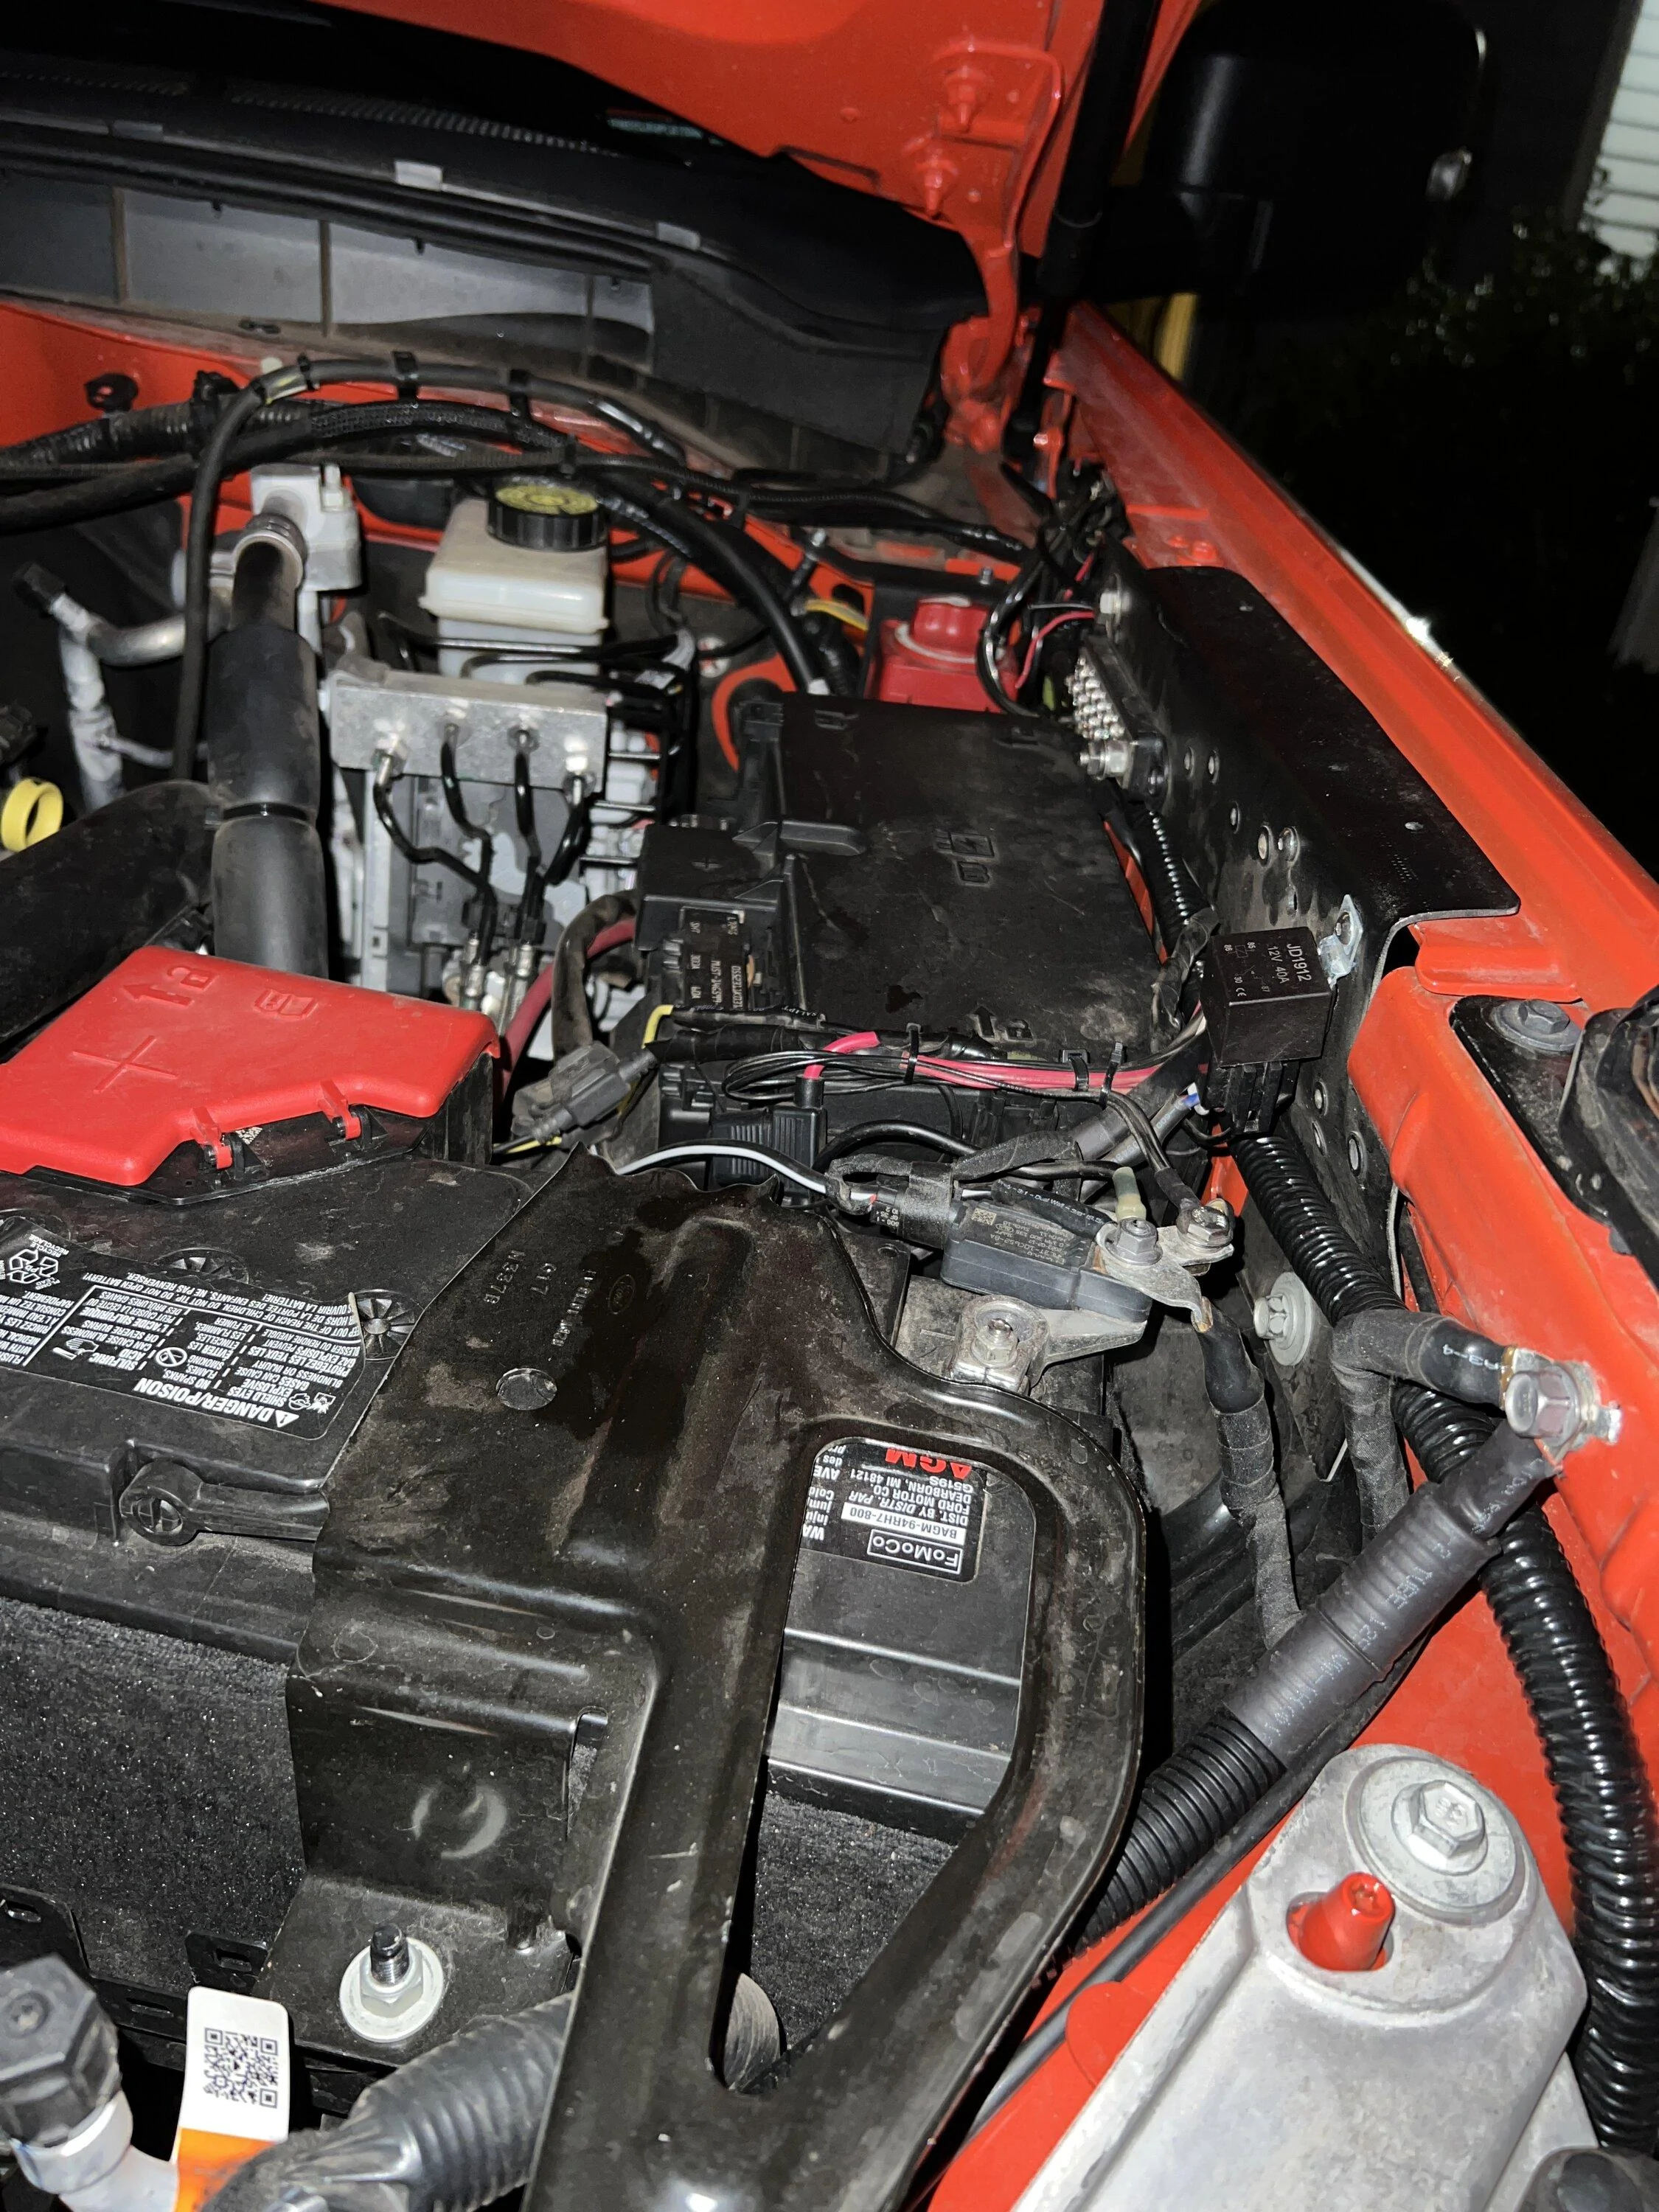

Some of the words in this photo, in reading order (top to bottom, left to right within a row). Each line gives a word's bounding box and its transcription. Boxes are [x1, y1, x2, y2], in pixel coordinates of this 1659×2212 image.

[1267, 946, 1283, 962] 12V
[1275, 966, 1290, 984] 40A
[1286, 943, 1312, 981] JD1912
[1034, 1194, 1050, 1203] Dual
[28, 1234, 69, 1256] RECYCLAGE
[29, 1240, 61, 1258] RECYCLE
[82, 1272, 122, 1287] BATTERY!
[126, 1272, 178, 1291] RENVERSER.
[119, 1281, 144, 1292] OPEN
[142, 1287, 161, 1297] NOT
[175, 1284, 195, 1295] PAS
[193, 1288, 209, 1298] NE
[6, 1297, 23, 1307] UN
[21, 1290, 75, 1309] RAPIDEMENT.
[159, 1291, 175, 1300] DO
[175, 1293, 190, 1304] TIP.
[209, 1291, 249, 1306] ENFANTS.
[261, 1293, 306, 1310] BATTERIE!
[18, 1300, 66, 1317] CONSULTEZ
[86, 1298, 100, 1307] OU
[188, 1298, 209, 1307] NOT
[206, 1301, 222, 1310] DO
[248, 1300, 268, 1310] DES
[305, 1303, 319, 1312] LA
[79, 1307, 136, 1325] SULFURIQUE
[119, 1304, 132, 1315] LA
[129, 1307, 159, 1320] CAUSER
[165, 1307, 183, 1315] DES
[222, 1303, 264, 1318] CHILDREN.
[316, 1304, 347, 1319] OUVRIR
[4, 1316, 24, 1329] LES
[155, 1313, 176, 1324] PEUT
[214, 1317, 243, 1329] FUMER
[262, 1312, 276, 1322] OF
[274, 1315, 305, 1328] REACH
[299, 1312, 313, 1321] LA
[311, 1314, 326, 1324] DE
[324, 1312, 349, 1326] HORS
[18, 1319, 52, 1335] RINCEZ
[81, 1320, 114, 1332] BURNS
[132, 1318, 170, 1333] L'ACIDE
[194, 1321, 232, 1338] FLAMMES,
[239, 1323, 253, 1332] DE
[302, 1321, 319, 1332] THE
[319, 1326, 333, 1335] OF
[7, 1331, 42, 1346] MEDICAL
[60, 1326, 108, 1342] BLINDNESS
[111, 1326, 146, 1340] SEVERE
[144, 1333, 159, 1343] OR
[229, 1330, 247, 1341] LES
[261, 1329, 295, 1342] AVEUGLE
[330, 1327, 349, 1338] OUT
[105, 1335, 135, 1348] CAUSE
[132, 1340, 153, 1352] CAN
[187, 1340, 204, 1352] LES
[262, 1339, 298, 1352] PEUVENT
[291, 1335, 321, 1349] RENDRE
[319, 1342, 333, 1352] OU
[7, 1343, 32, 1356] WITH
[118, 1348, 147, 1361] ACID
[201, 1344, 234, 1361] ÉVITER
[247, 1346, 267, 1357] LES
[263, 1349, 289, 1363] YEUX
[293, 1346, 340, 1364] EXPLOSIFS
[88, 1352, 139, 1371] SULFURIC
[187, 1354, 225, 1371] SMOKING
[288, 1354, 307, 1366] LES
[337, 1357, 356, 1368] GAZ
[185, 1363, 218, 1380] FLAMES,
[234, 1366, 263, 1379] CAUSE
[251, 1360, 285, 1374] INJURY
[282, 1366, 297, 1377] OR
[304, 1358, 352, 1377] PROTÉGEZ
[162, 1368, 197, 1385] SPARKS,
[261, 1371, 281, 1383] CAN
[294, 1369, 344, 1388] BLINDNESS
[194, 1378, 212, 1390] NO
[240, 1378, 294, 1398] EXPLOSIVE
[278, 1376, 310, 1391] GASES
[226, 1386, 254, 1399] EYES
[133, 1377, 275, 1422] DANGER/POISON
[251, 1391, 288, 1408] SHIELD
[822, 1454, 843, 1467] des
[886, 1449, 970, 1479] AGM
[850, 1468, 884, 1484] 48121
[886, 1476, 901, 1489] MI
[870, 1484, 889, 1497] CO.
[905, 1478, 973, 1505] DEARBORN,
[848, 1490, 874, 1505] PAR
[892, 1488, 935, 1508] MOTOR
[877, 1496, 917, 1514] DISTR.
[938, 1499, 970, 1515] FORD
[919, 1506, 936, 1519] BY
[939, 1510, 968, 1526] DIST.
[849, 1507, 957, 1540] BAGM-94RH7-800
[872, 1536, 959, 1568] FoMoCo
